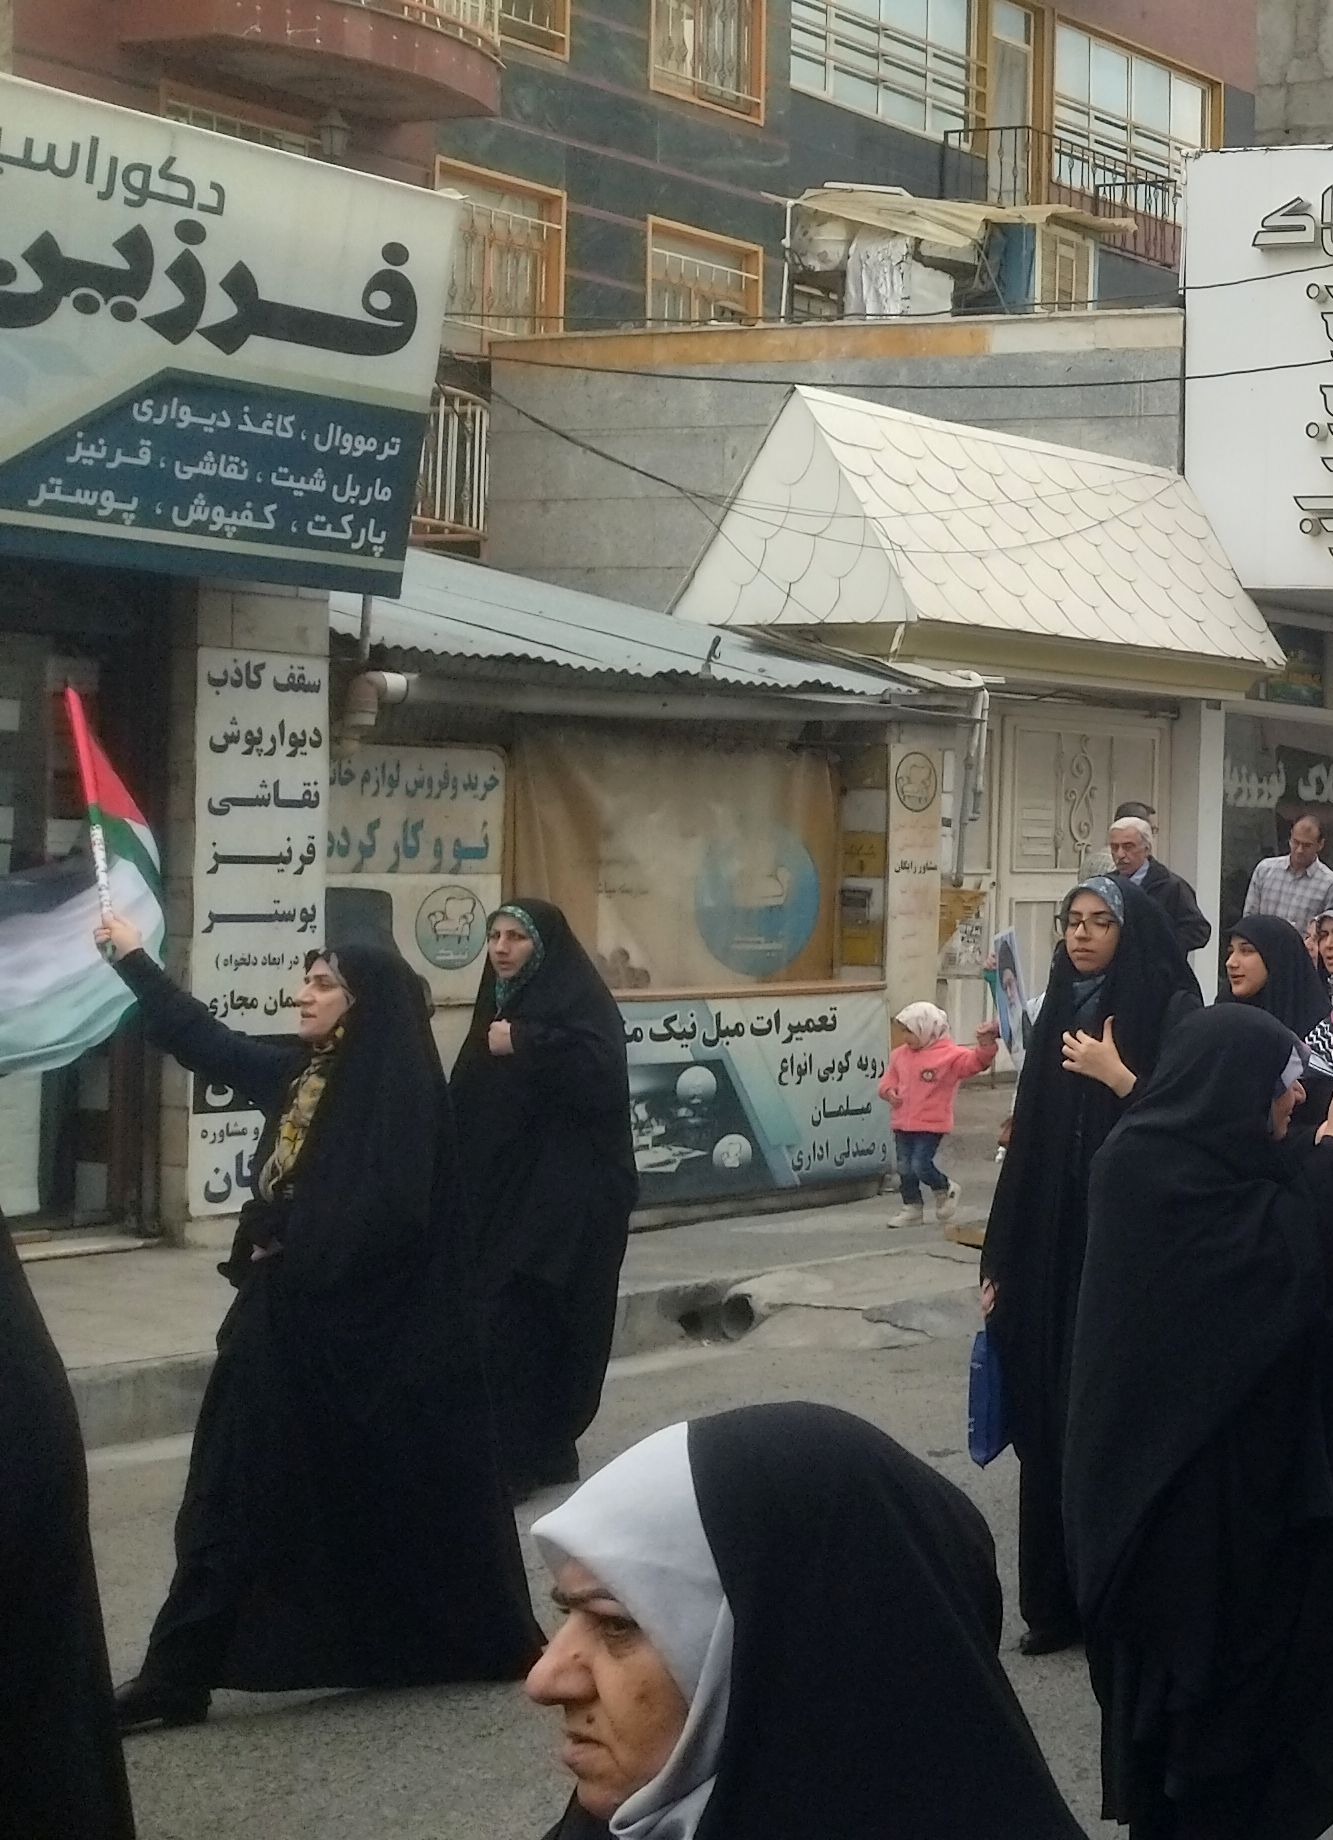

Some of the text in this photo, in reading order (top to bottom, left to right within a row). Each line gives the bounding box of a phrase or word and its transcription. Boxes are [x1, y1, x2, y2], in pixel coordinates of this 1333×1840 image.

[132, 397, 231, 433] دیواری
[238, 403, 295, 439] کاغذ
[66, 431, 152, 469] قرنیز
[174, 451, 249, 480] نقاشی
[270, 467, 326, 496] شیت
[332, 474, 392, 506] ماربل
[28, 475, 139, 525] پوستر
[172, 492, 278, 538] کفپوش
[306, 512, 387, 558] پارکت
[207, 659, 321, 695] سقف کاذب
[209, 716, 323, 758] دیوارپوش
[361, 760, 401, 797] لوازم
[463, 767, 499, 800] خرید
[207, 779, 320, 816] نقاشی
[207, 835, 317, 875] قرنیز
[201, 898, 317, 933] پوستر
[262, 952, 284, 968] ابعاد
[208, 987, 300, 1018] مان مجازی
[649, 1012, 697, 1049] نیک
[702, 1011, 745, 1047] مبل
[750, 1006, 838, 1043] تعمیرات
[778, 1051, 885, 1086] رویه کوبی انواع
[811, 1098, 872, 1127] مبلمان
[201, 1121, 248, 1144] مشاوره
[791, 1139, 831, 1172] اداری
[834, 1139, 875, 1167] صندلی
